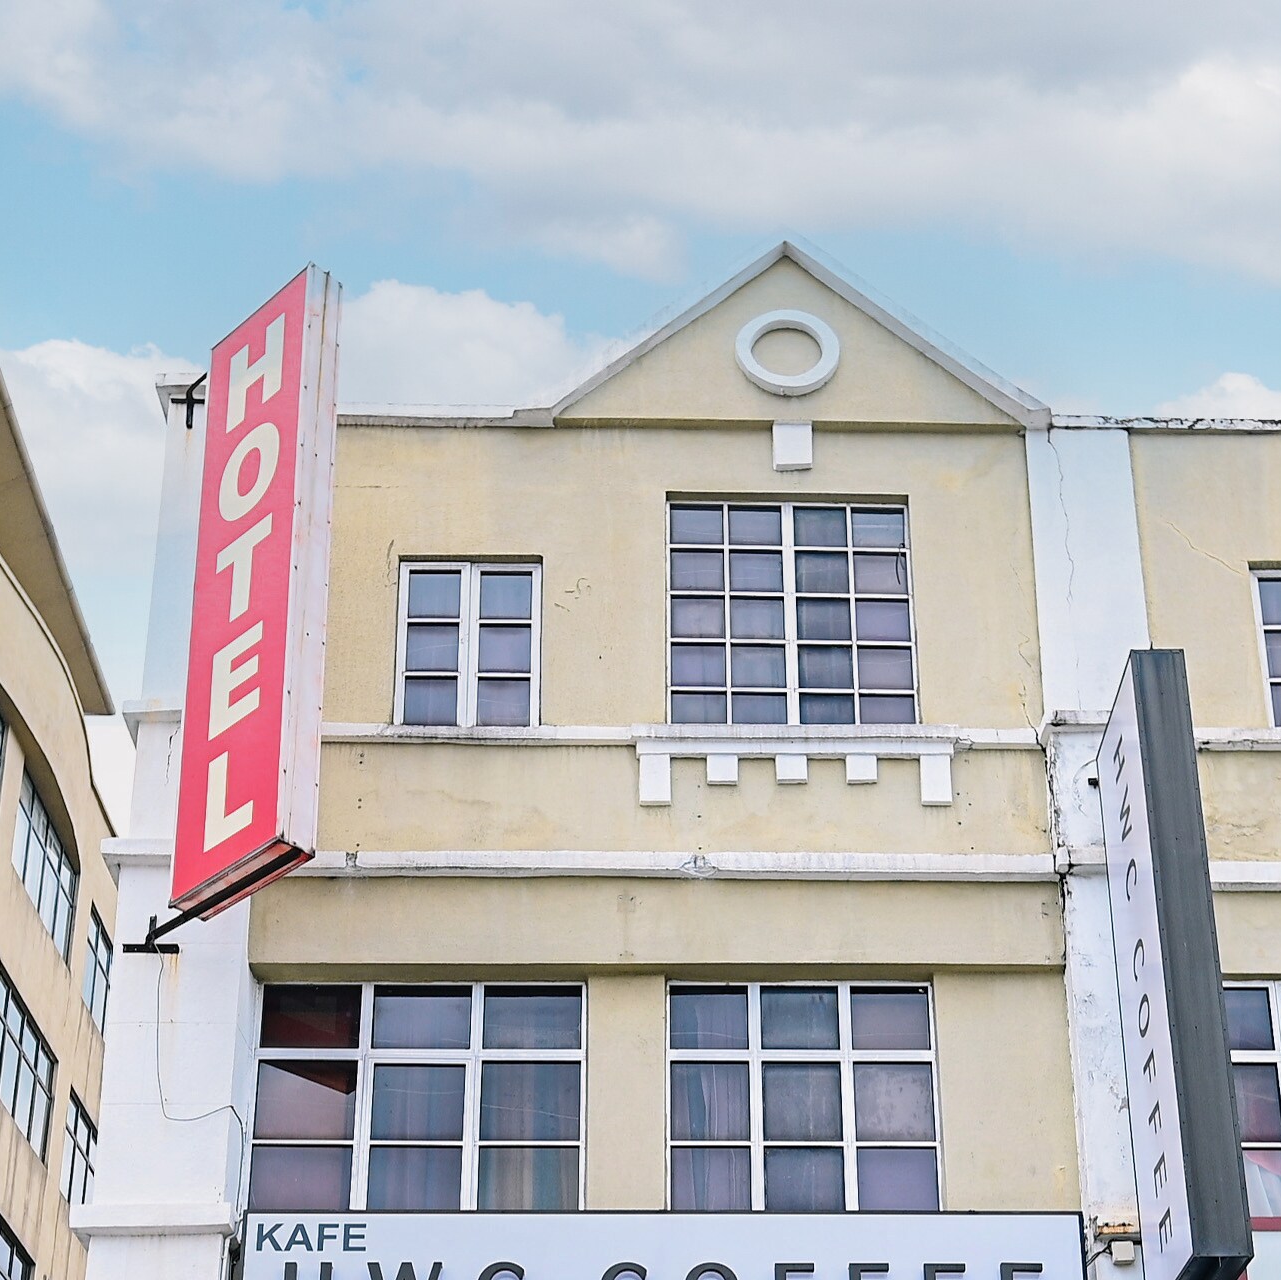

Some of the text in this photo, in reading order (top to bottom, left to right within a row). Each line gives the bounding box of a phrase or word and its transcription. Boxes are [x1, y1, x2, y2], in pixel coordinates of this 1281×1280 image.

[203, 313, 285, 853] HOTEL
[255, 1222, 367, 1252] KAFE
[1112, 733, 1174, 1255] HWC COFFEE
